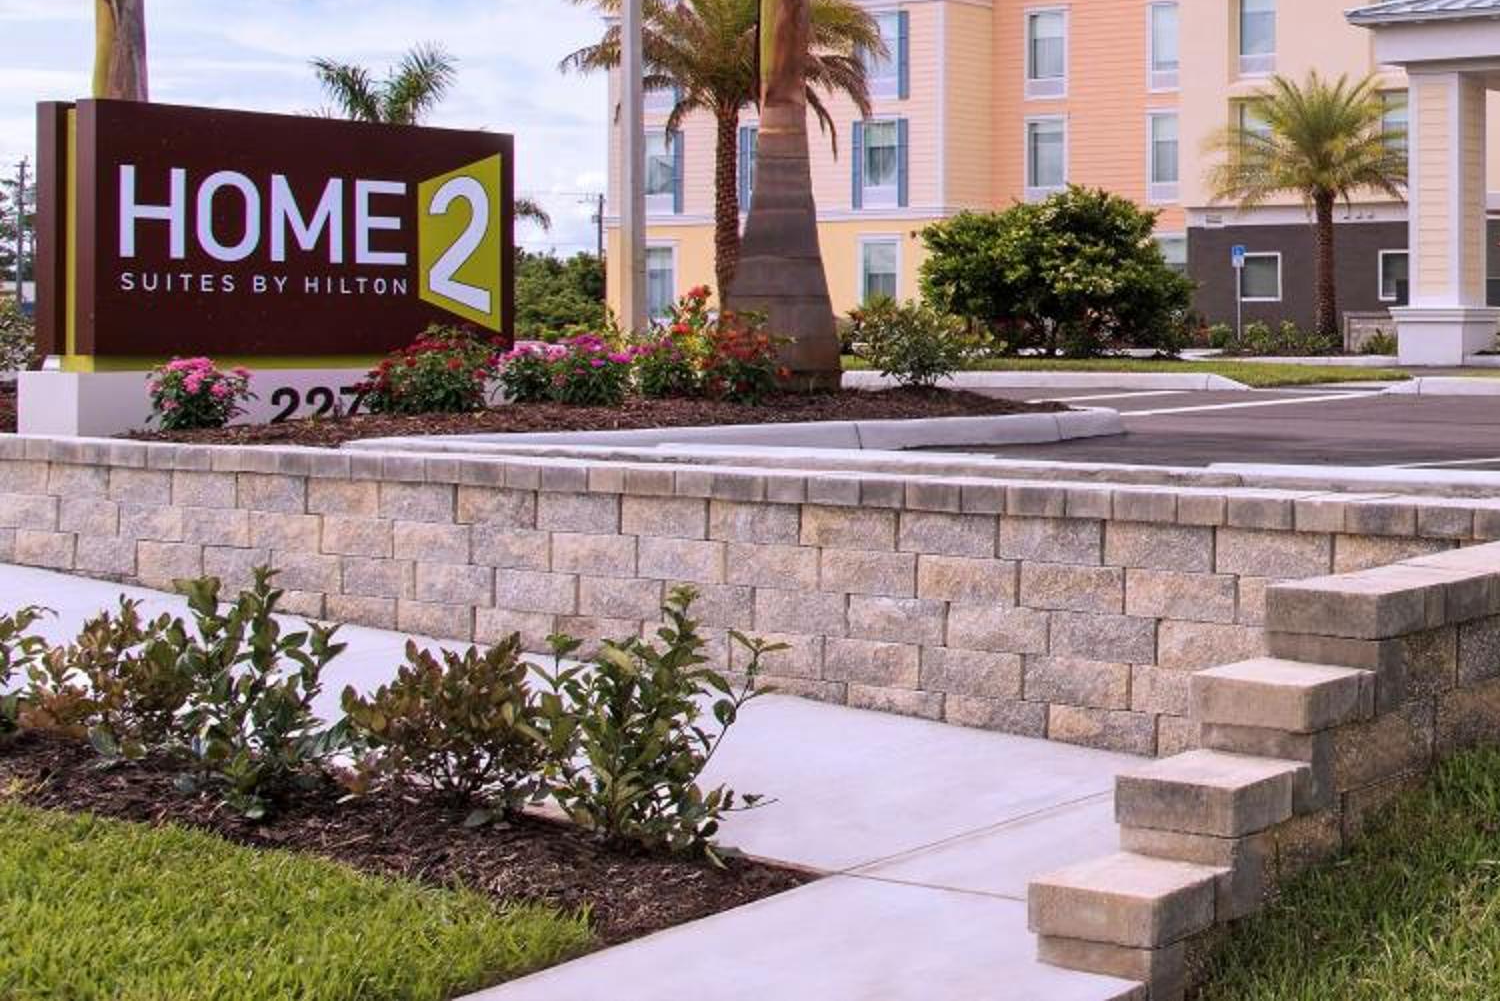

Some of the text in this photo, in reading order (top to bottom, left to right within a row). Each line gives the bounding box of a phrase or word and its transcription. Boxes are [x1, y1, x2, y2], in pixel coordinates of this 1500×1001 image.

[119, 164, 492, 315] HOME 2
[120, 272, 408, 296] SUITES BY HILTON
[270, 386, 362, 424] 227
